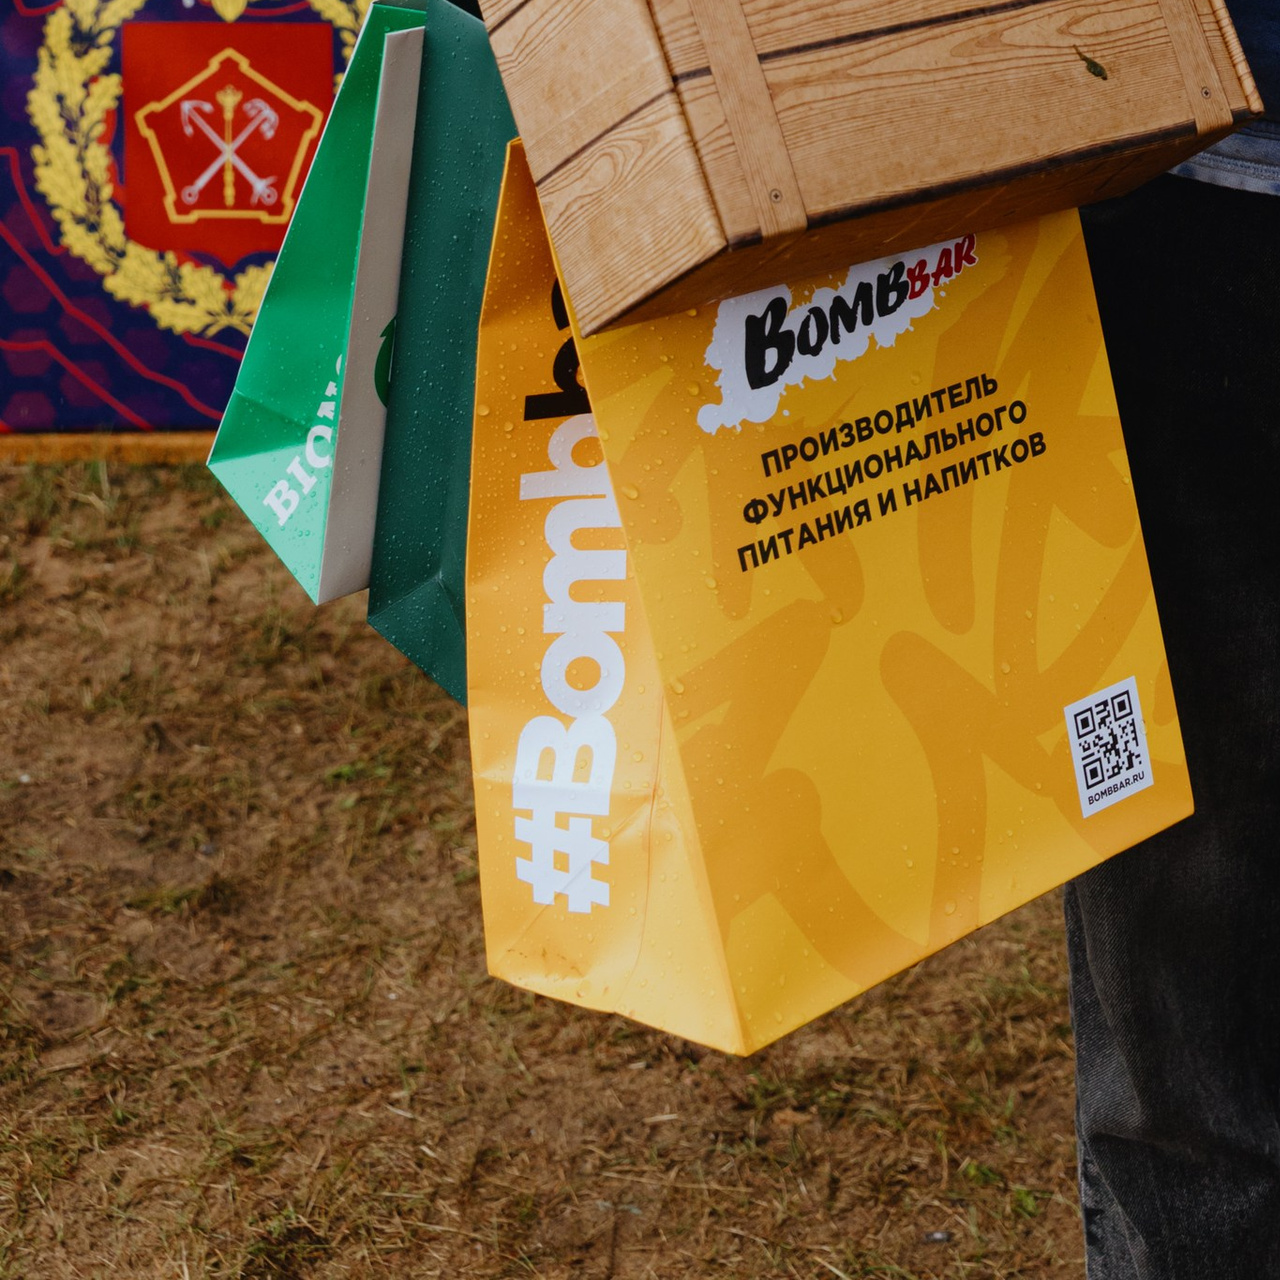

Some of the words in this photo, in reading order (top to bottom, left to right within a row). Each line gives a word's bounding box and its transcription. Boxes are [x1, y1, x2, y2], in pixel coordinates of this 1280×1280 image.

[742, 399, 1028, 526] ФУНКЦИОНАЛЬНОГО
[760, 372, 999, 478] ПРОИЗВОДИТЕЛЬ
[736, 498, 872, 573] ПИТАНИЯ
[877, 488, 898, 517] И
[902, 431, 1048, 507] НАПИТКОВ
[1087, 770, 1146, 806] BOMBBAR.RU
